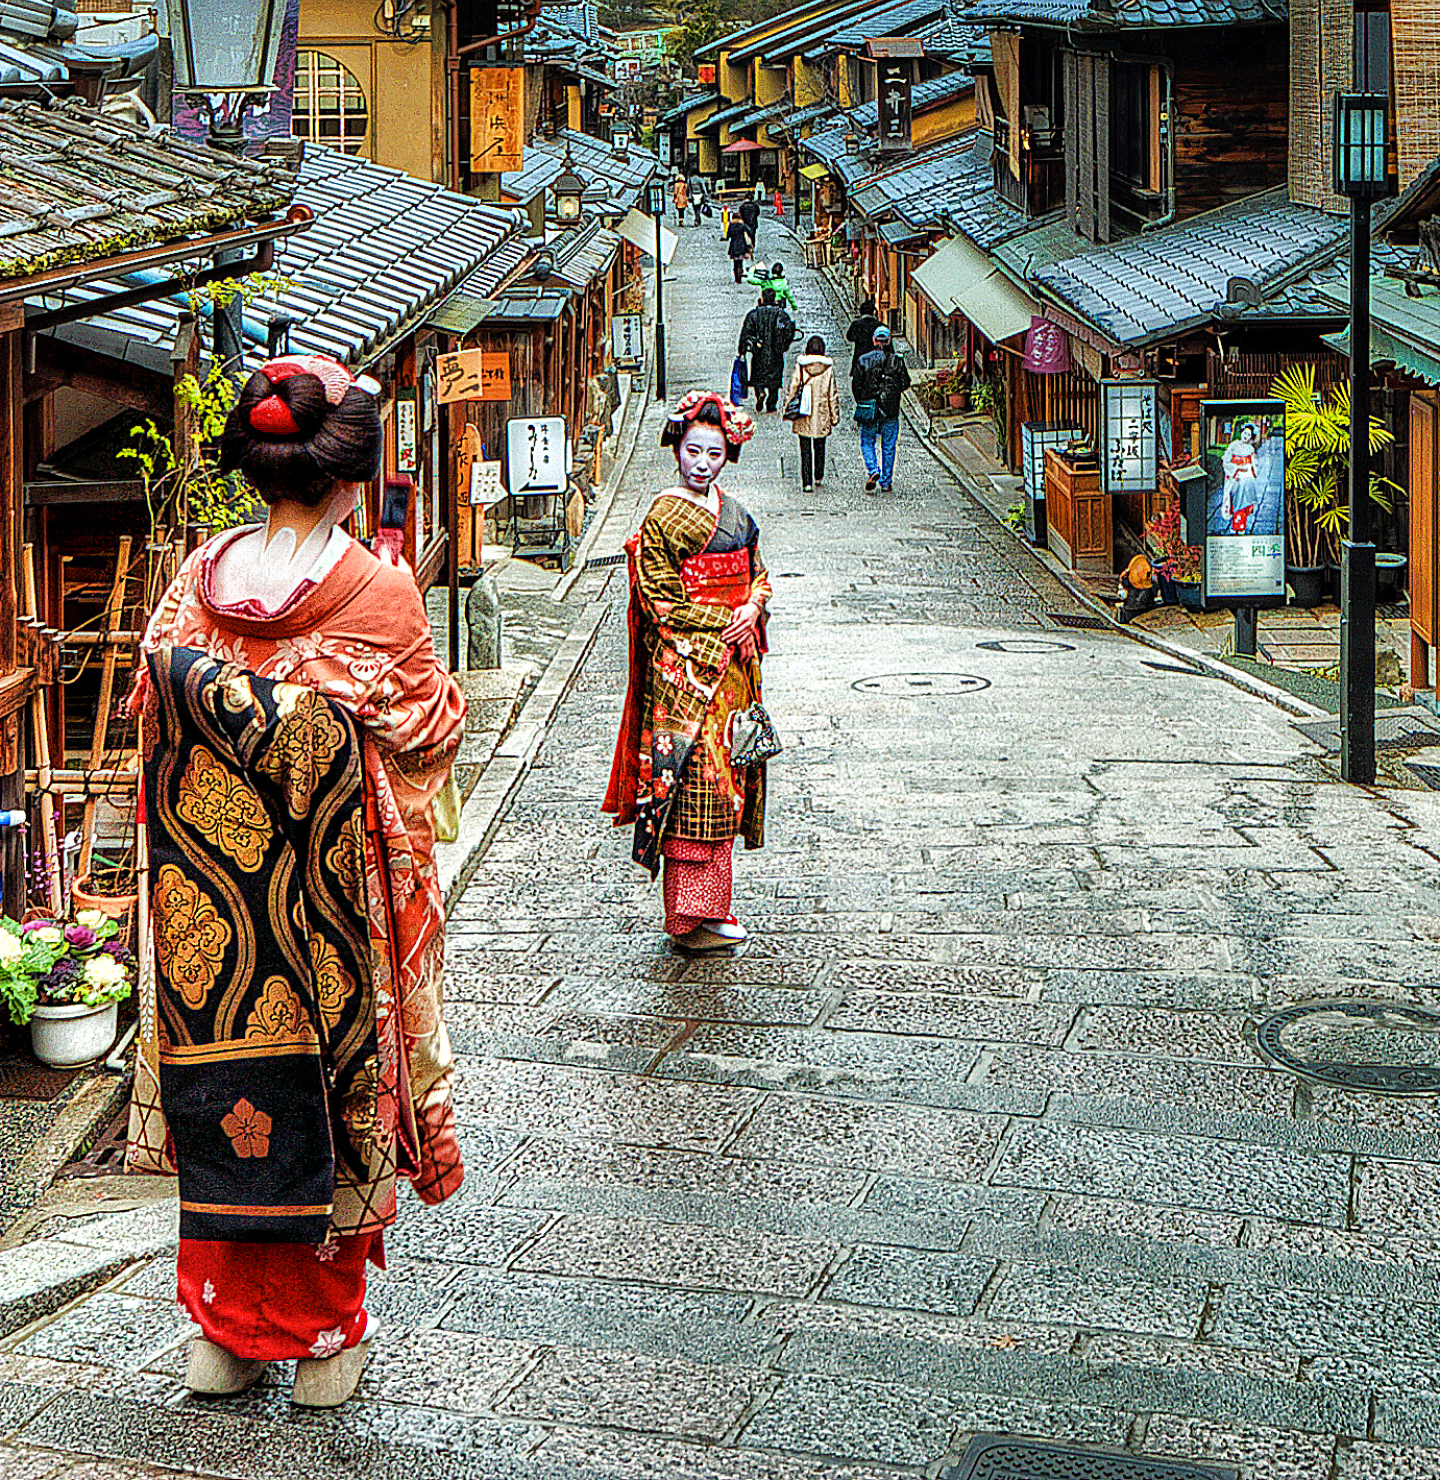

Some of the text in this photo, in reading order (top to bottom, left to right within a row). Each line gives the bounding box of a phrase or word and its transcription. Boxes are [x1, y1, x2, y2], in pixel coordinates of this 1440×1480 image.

[884, 66, 907, 138] 二井三
[440, 355, 480, 397] 夢二
